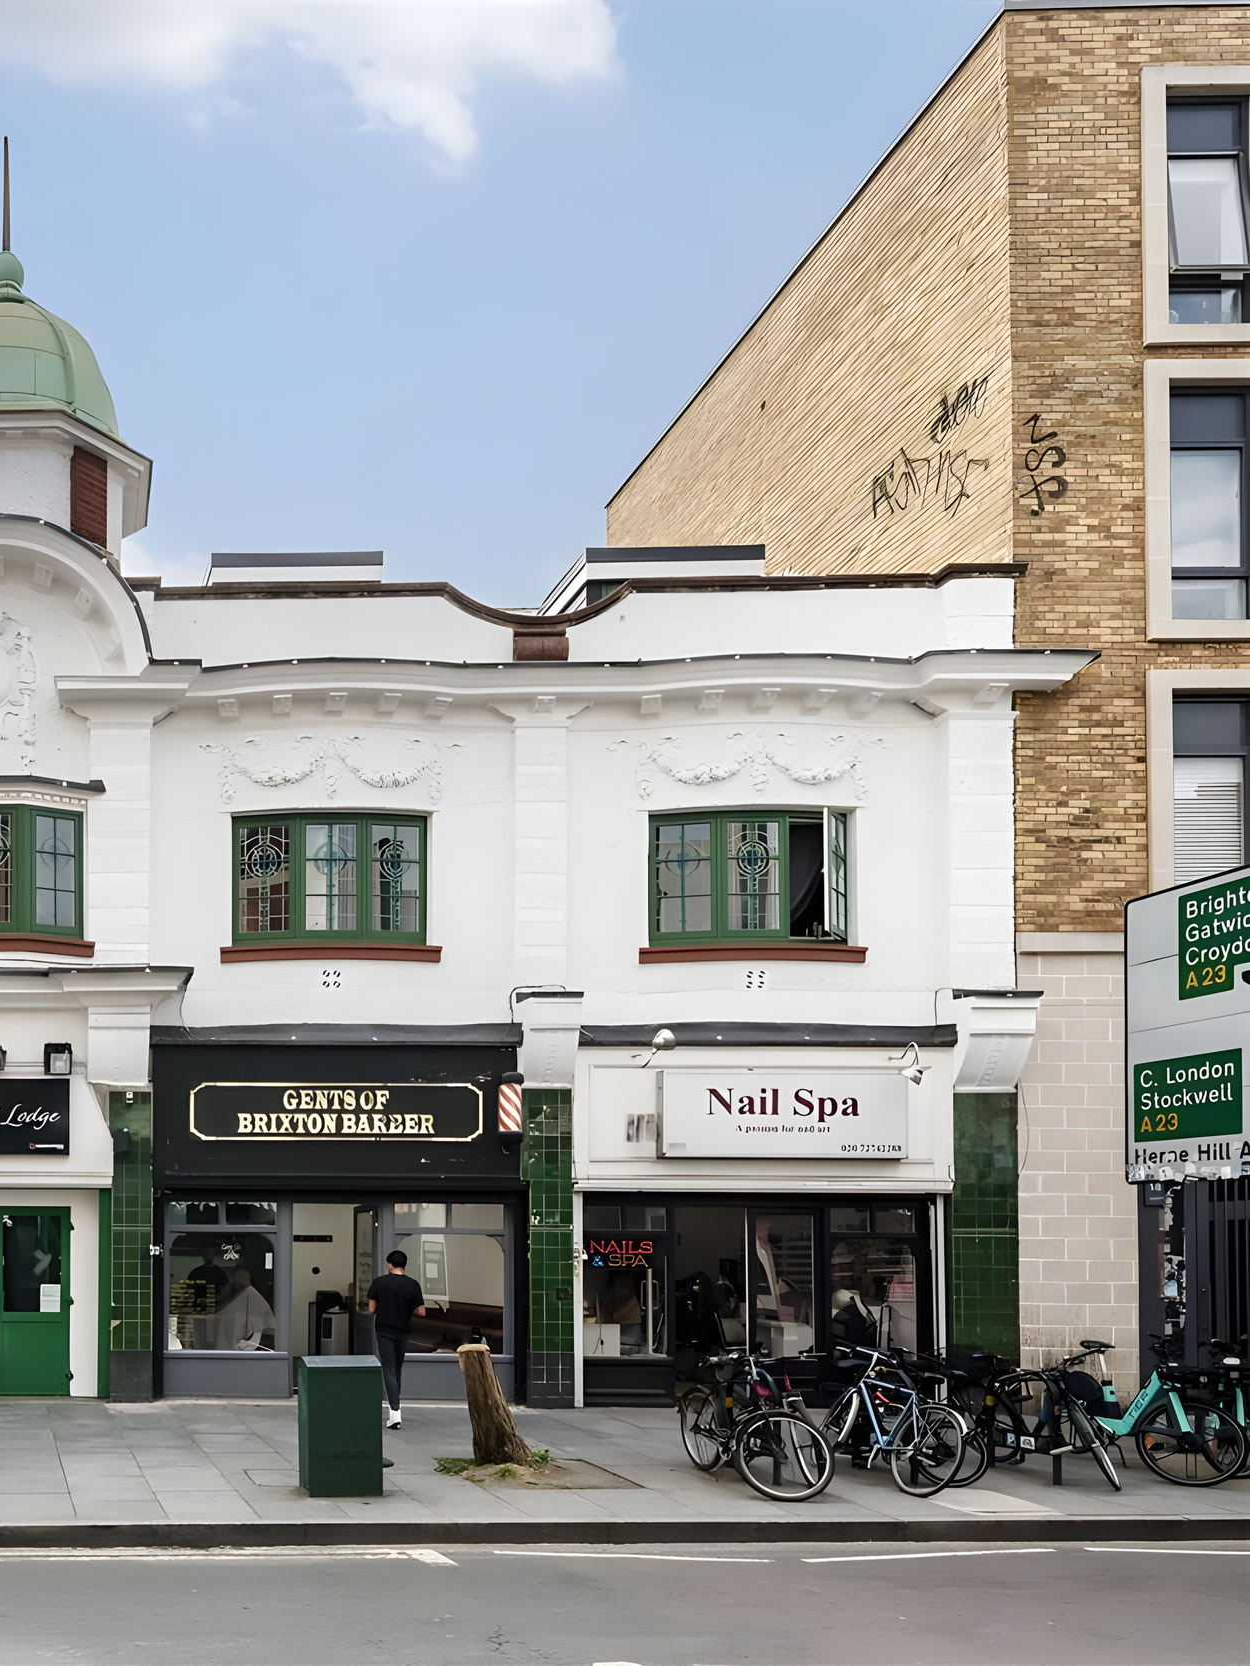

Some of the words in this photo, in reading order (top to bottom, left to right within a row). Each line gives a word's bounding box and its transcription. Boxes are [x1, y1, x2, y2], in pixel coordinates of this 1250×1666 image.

[1140, 1069, 1158, 1088] C.
[1166, 1061, 1235, 1084] London
[282, 1089, 357, 1110] GENTS
[359, 1090, 390, 1110] OF
[706, 1087, 780, 1116] Nail
[793, 1088, 860, 1123] Spa
[1140, 1082, 1234, 1111] Stockwell
[0, 1103, 61, 1131] Lodge
[237, 1113, 339, 1134] BRIXTON
[1197, 1142, 1232, 1161] Hill
[589, 1240, 653, 1254] NAILS
[607, 1253, 649, 1267] SPA
